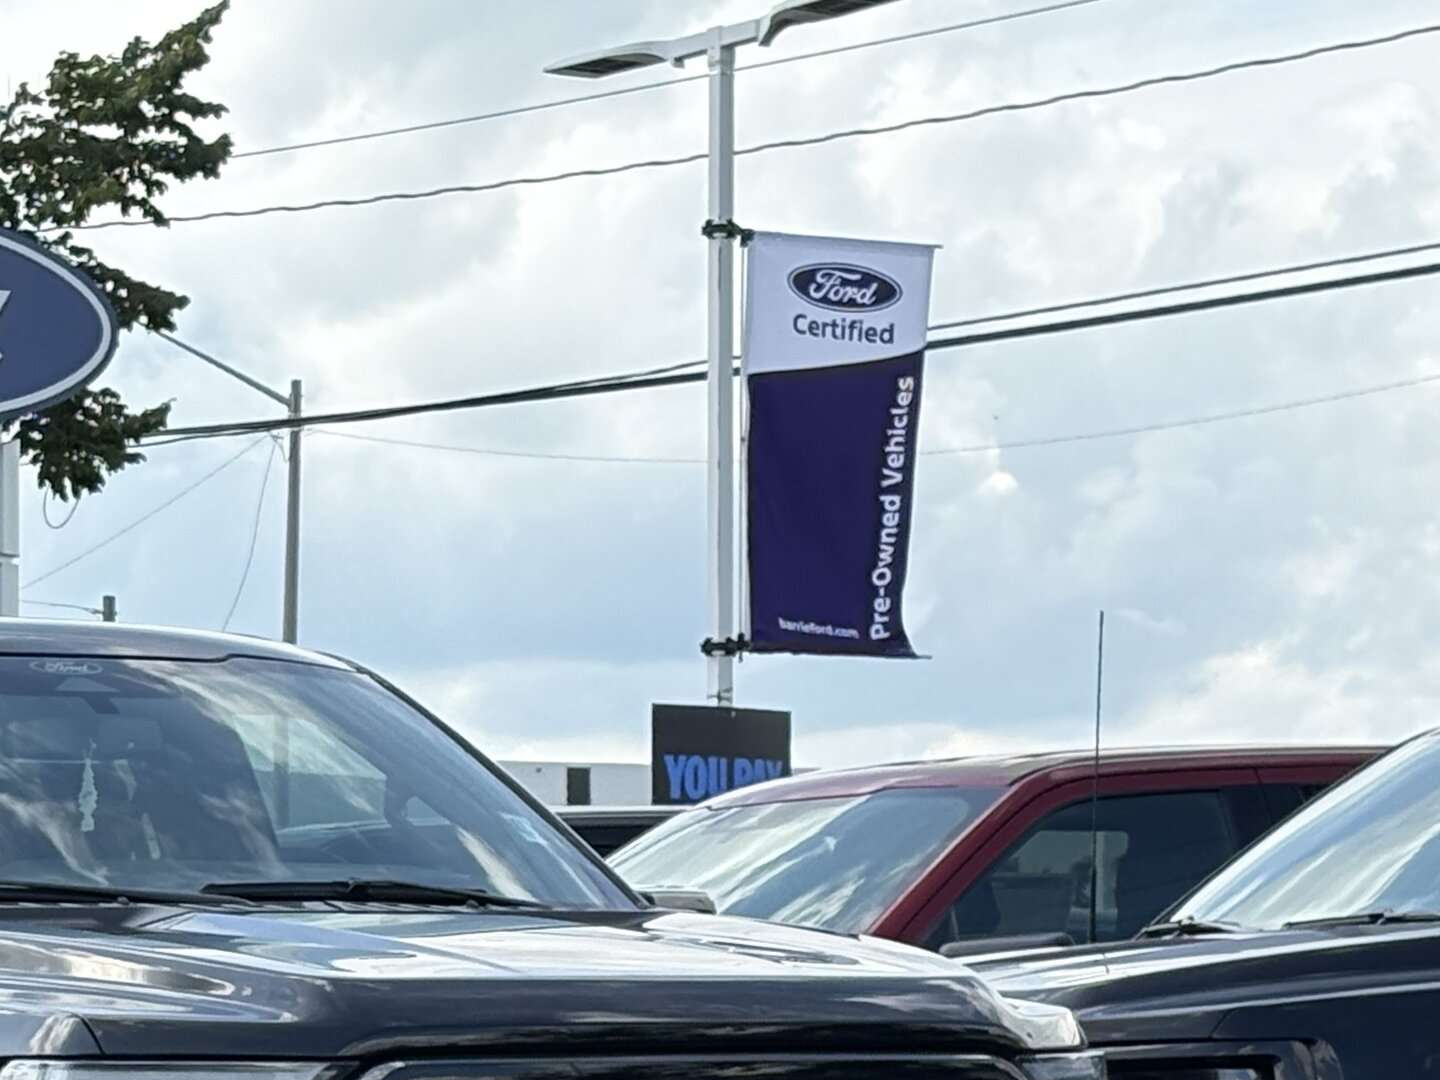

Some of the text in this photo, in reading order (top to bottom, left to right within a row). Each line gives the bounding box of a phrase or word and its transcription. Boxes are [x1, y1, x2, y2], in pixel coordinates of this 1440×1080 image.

[809, 269, 877, 306] Ford
[792, 314, 895, 345] Certified
[869, 376, 915, 641] Pre-Owned Vehicles
[663, 754, 728, 800] YOU
